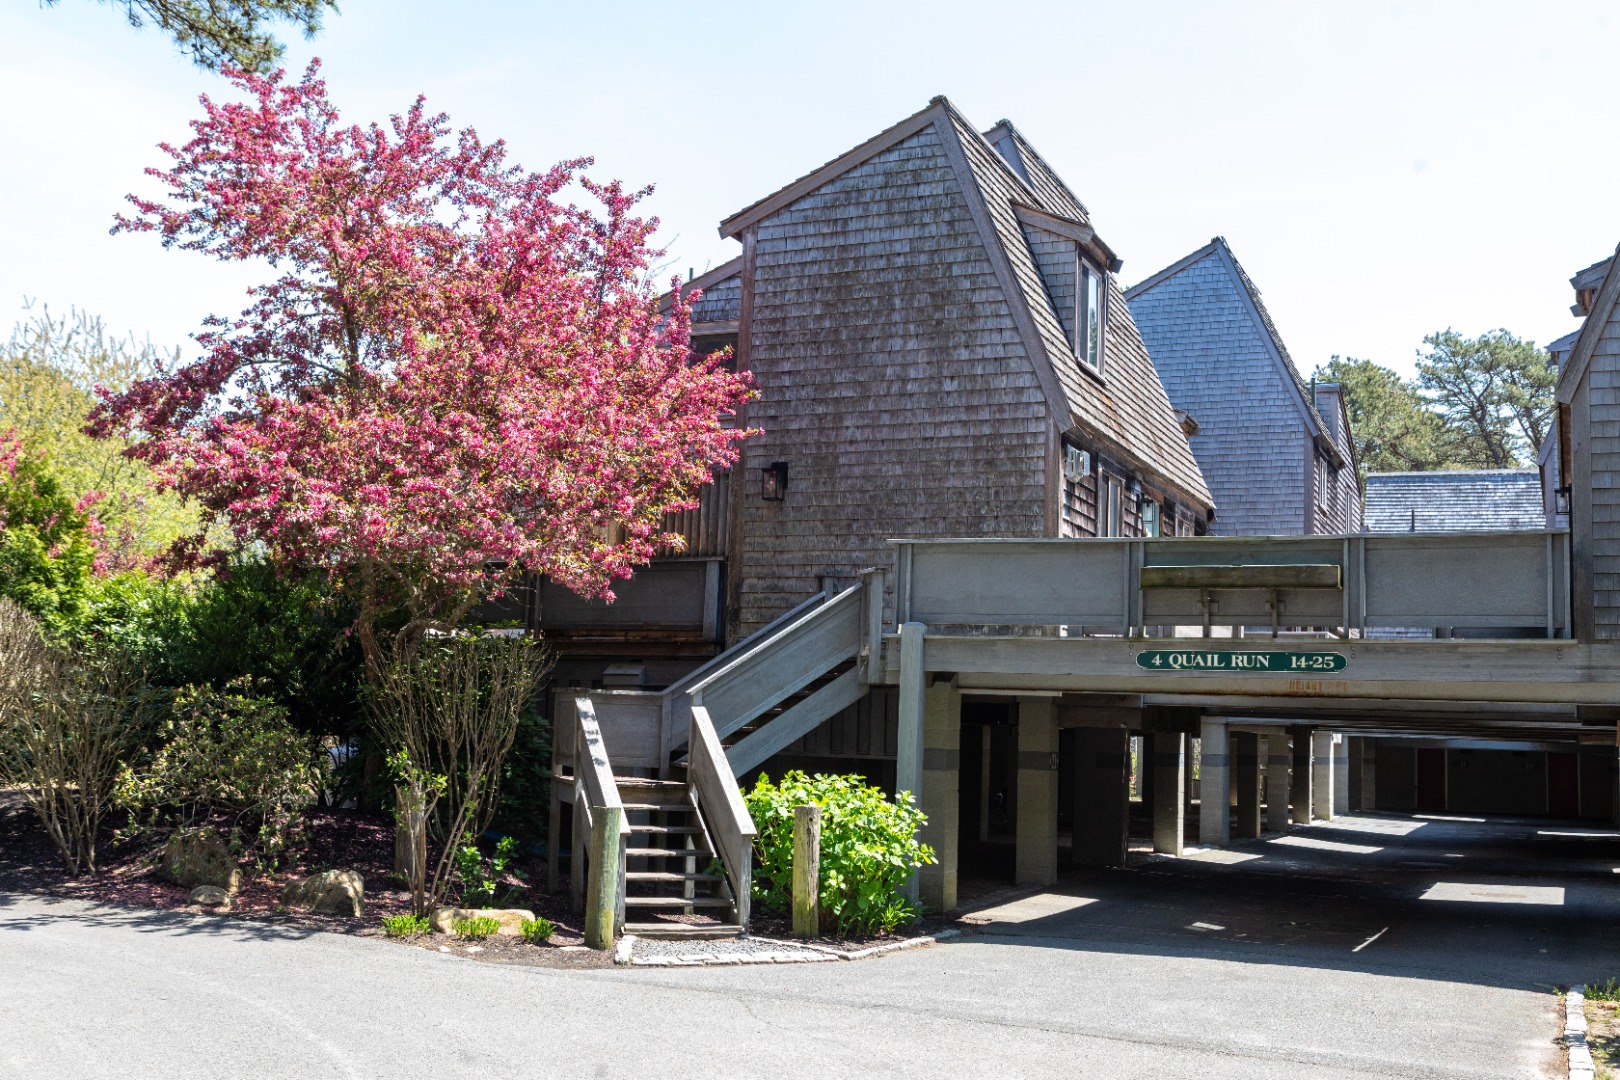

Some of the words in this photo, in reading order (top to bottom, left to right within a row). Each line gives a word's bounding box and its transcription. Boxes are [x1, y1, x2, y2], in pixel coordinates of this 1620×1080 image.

[1151, 653, 1163, 666] 4
[1168, 653, 1226, 669] QUAIL
[1230, 654, 1270, 668] RUN
[1290, 656, 1335, 669] 14-25
